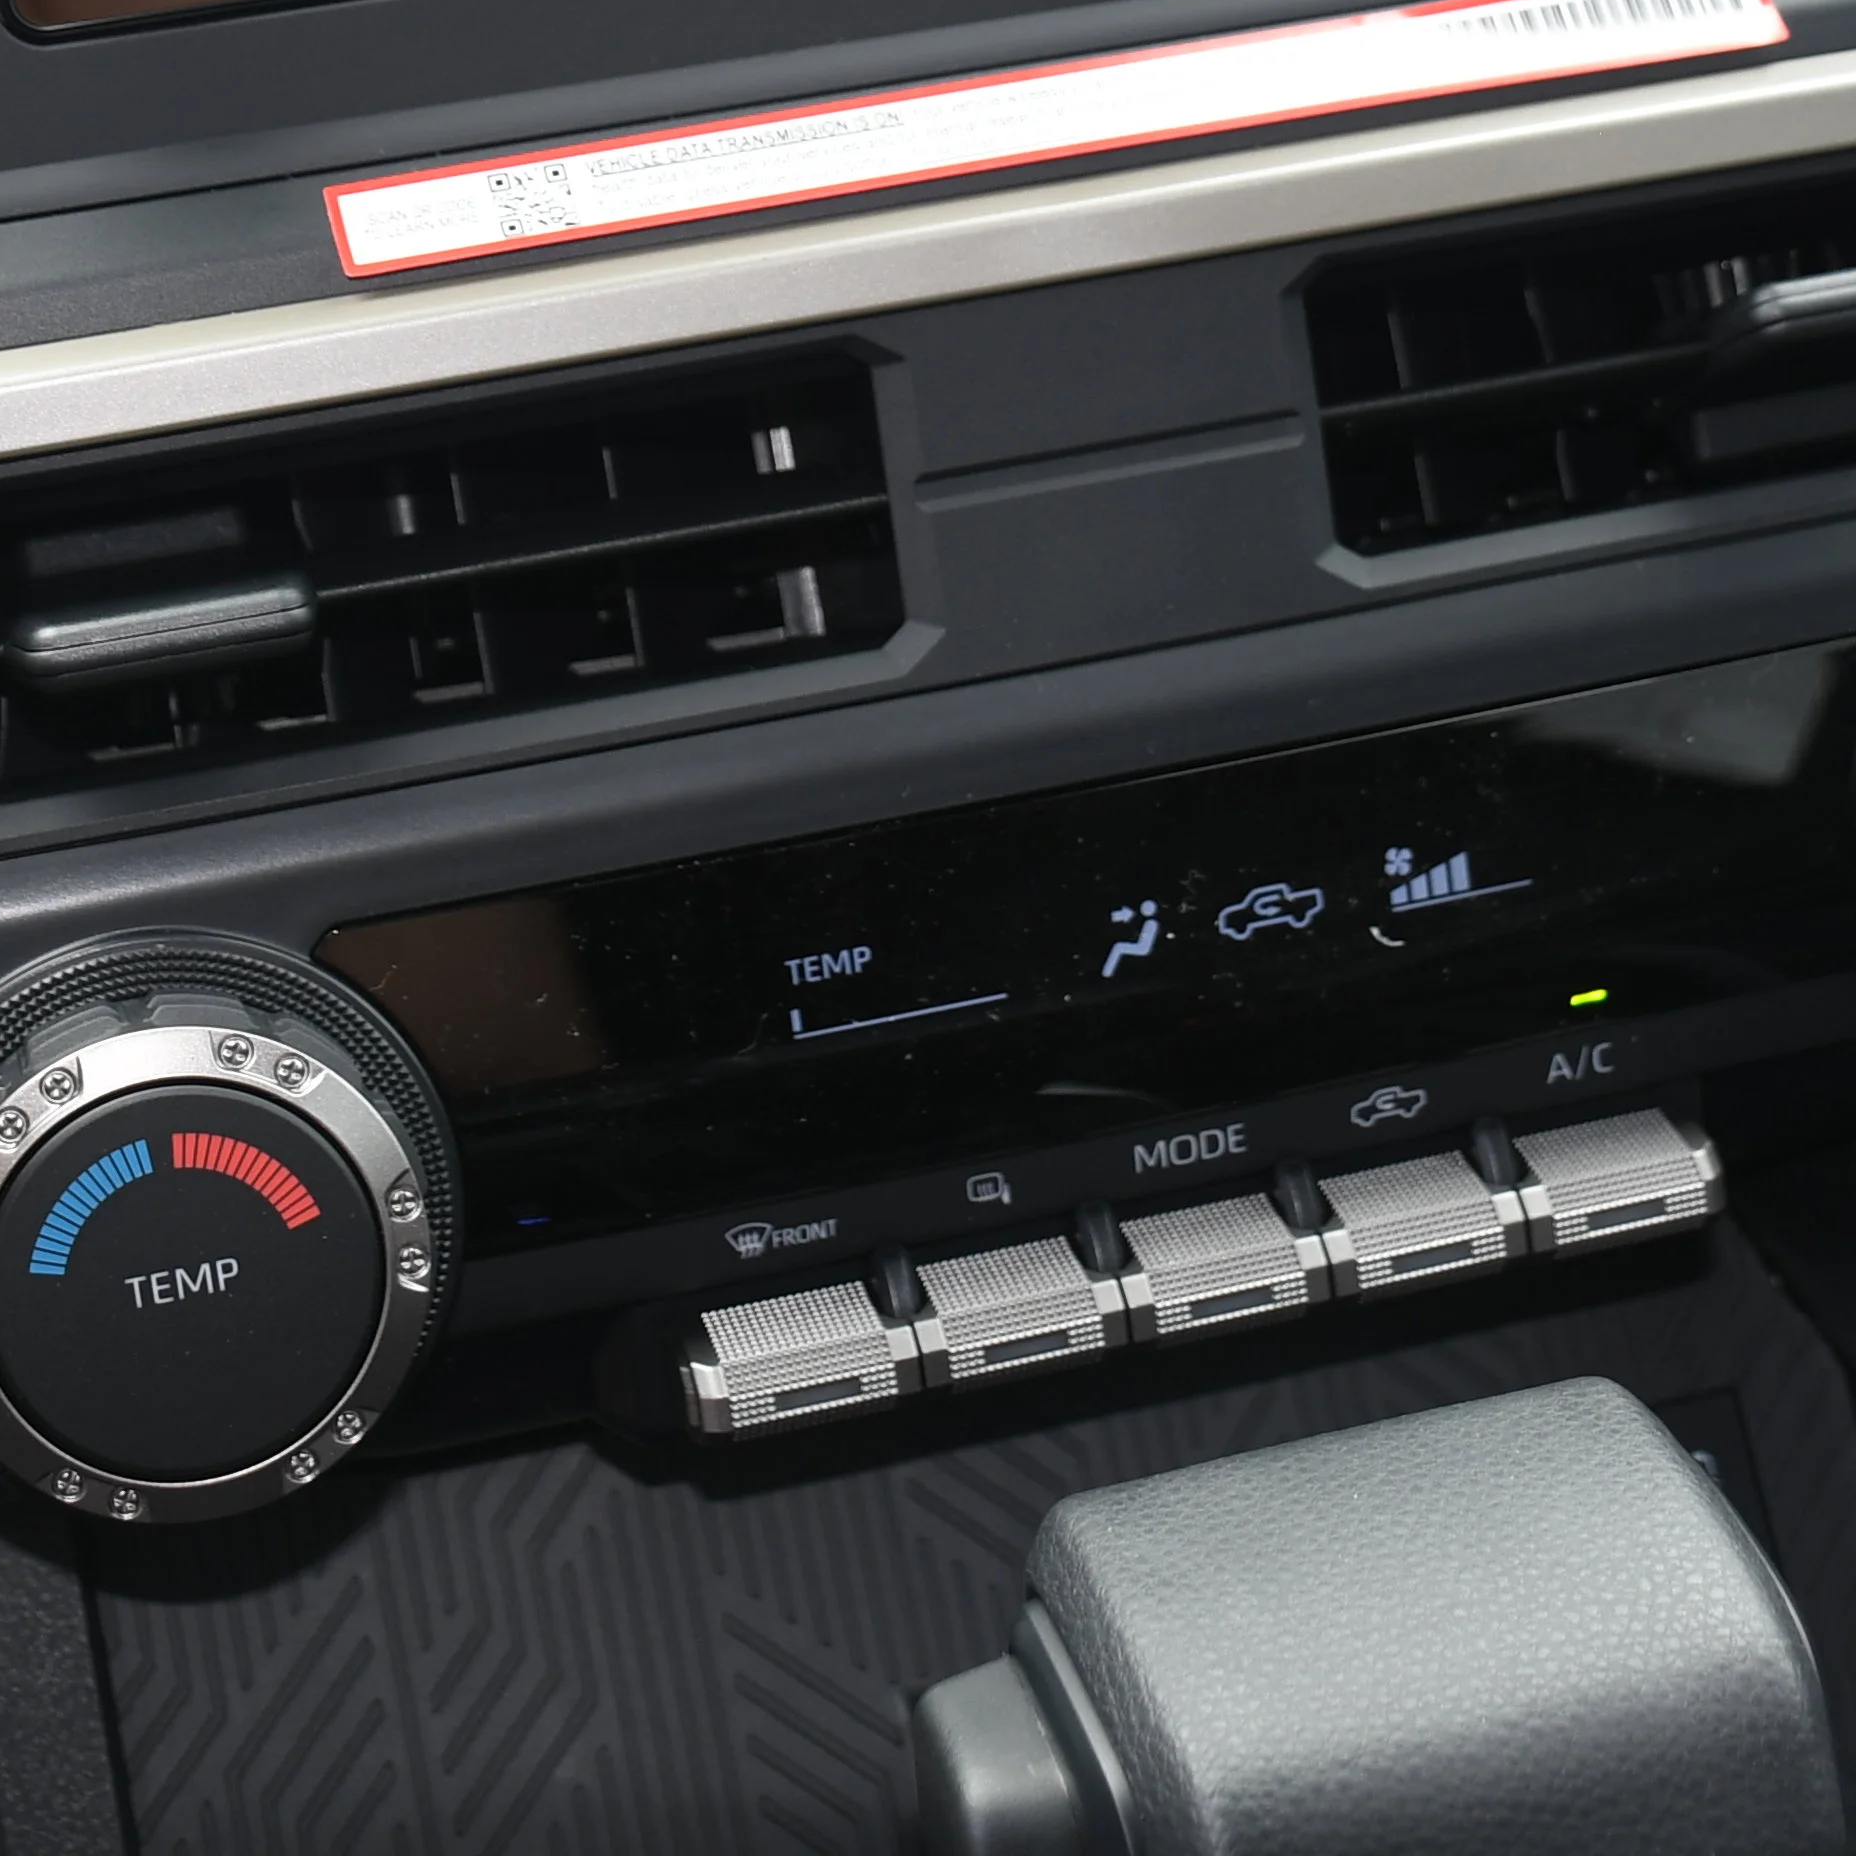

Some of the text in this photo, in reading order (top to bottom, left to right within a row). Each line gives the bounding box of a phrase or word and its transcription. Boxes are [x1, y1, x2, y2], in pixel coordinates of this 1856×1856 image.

[784, 945, 874, 986] TEMP
[1546, 1042, 1615, 1084] A/C
[1132, 1122, 1248, 1174] MODE
[770, 1217, 839, 1248] FRONT
[125, 1257, 240, 1310] TEMP
